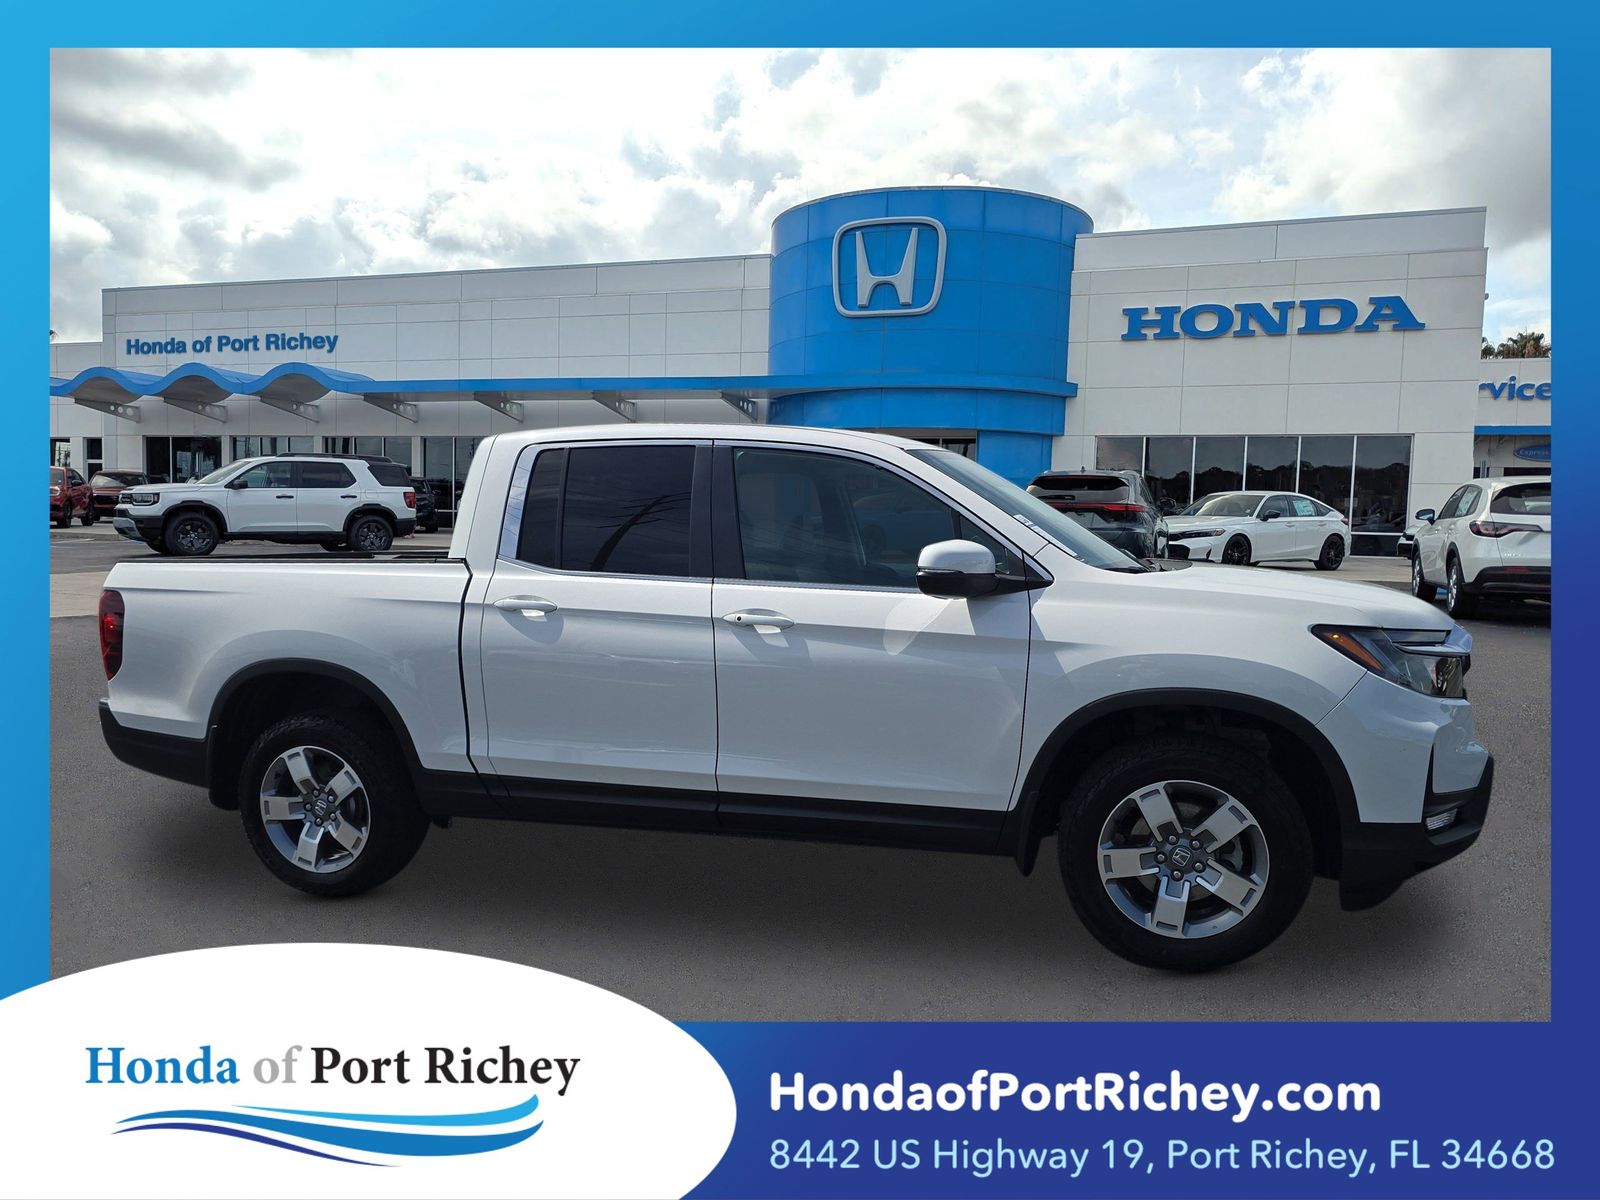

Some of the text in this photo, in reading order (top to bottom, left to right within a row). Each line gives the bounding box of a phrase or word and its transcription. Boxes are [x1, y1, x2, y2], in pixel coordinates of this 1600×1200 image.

[1120, 295, 1425, 340] HONDA
[126, 332, 339, 355] Honda of Port Richey
